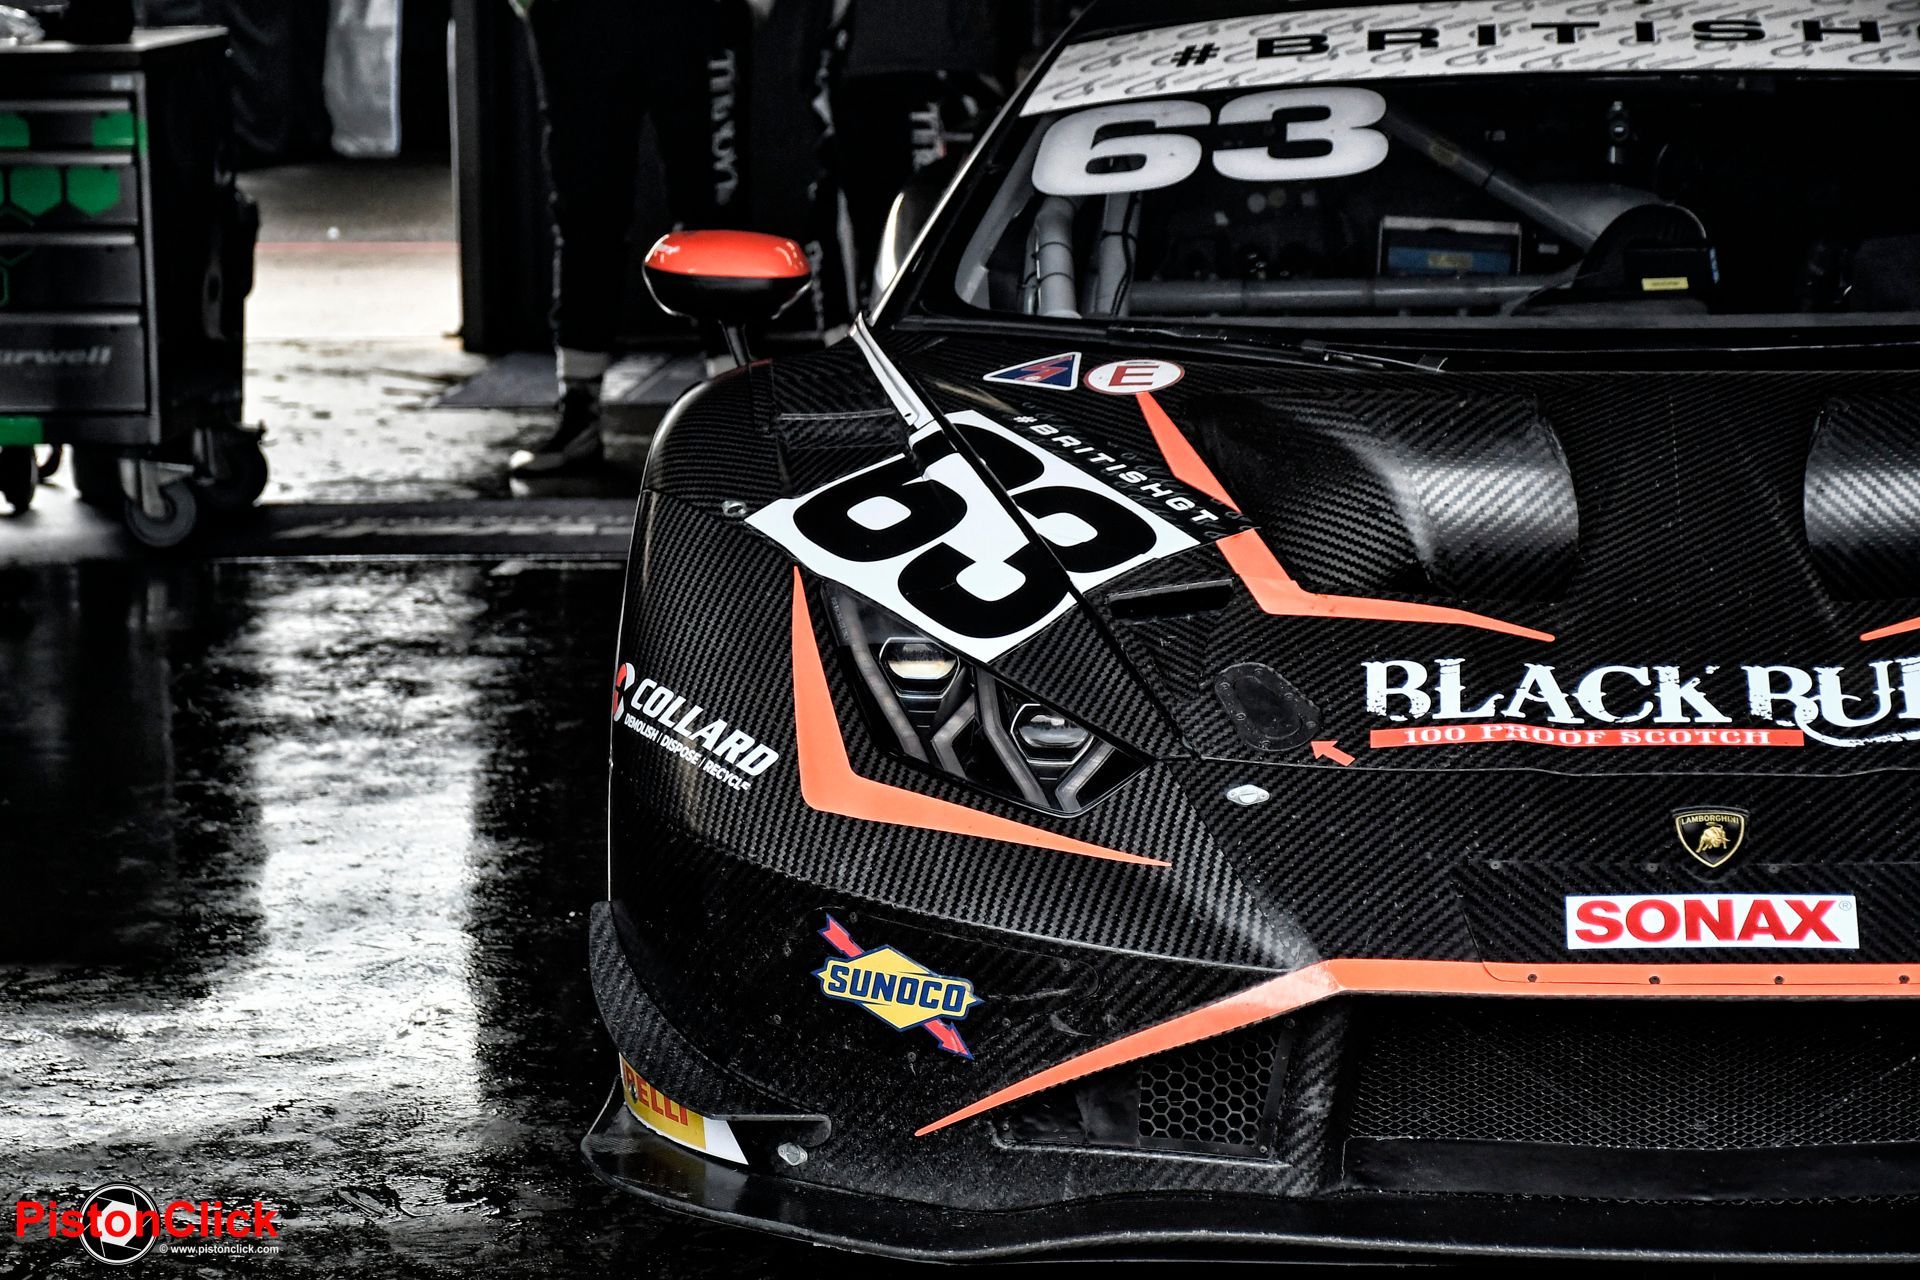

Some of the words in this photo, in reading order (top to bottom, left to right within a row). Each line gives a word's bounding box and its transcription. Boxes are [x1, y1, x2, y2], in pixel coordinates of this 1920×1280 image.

[1031, 88, 1390, 196] 63
[1109, 365, 1159, 387] E
[1013, 415, 1220, 523] #BRITISHGT
[794, 422, 1158, 639] 63
[1361, 657, 1732, 725] BLACK
[623, 713, 659, 741] DEMOLISH
[660, 735, 702, 766] DISPOSE
[631, 678, 780, 777] COLLARD
[1404, 728, 1466, 744] 100
[1480, 725, 1606, 745] PROOF
[1621, 731, 1770, 745] SCOTCH
[1681, 814, 1740, 826] LAMBORGHINI
[1575, 899, 1842, 943] SONAX
[827, 964, 968, 1013] SUNOCO
